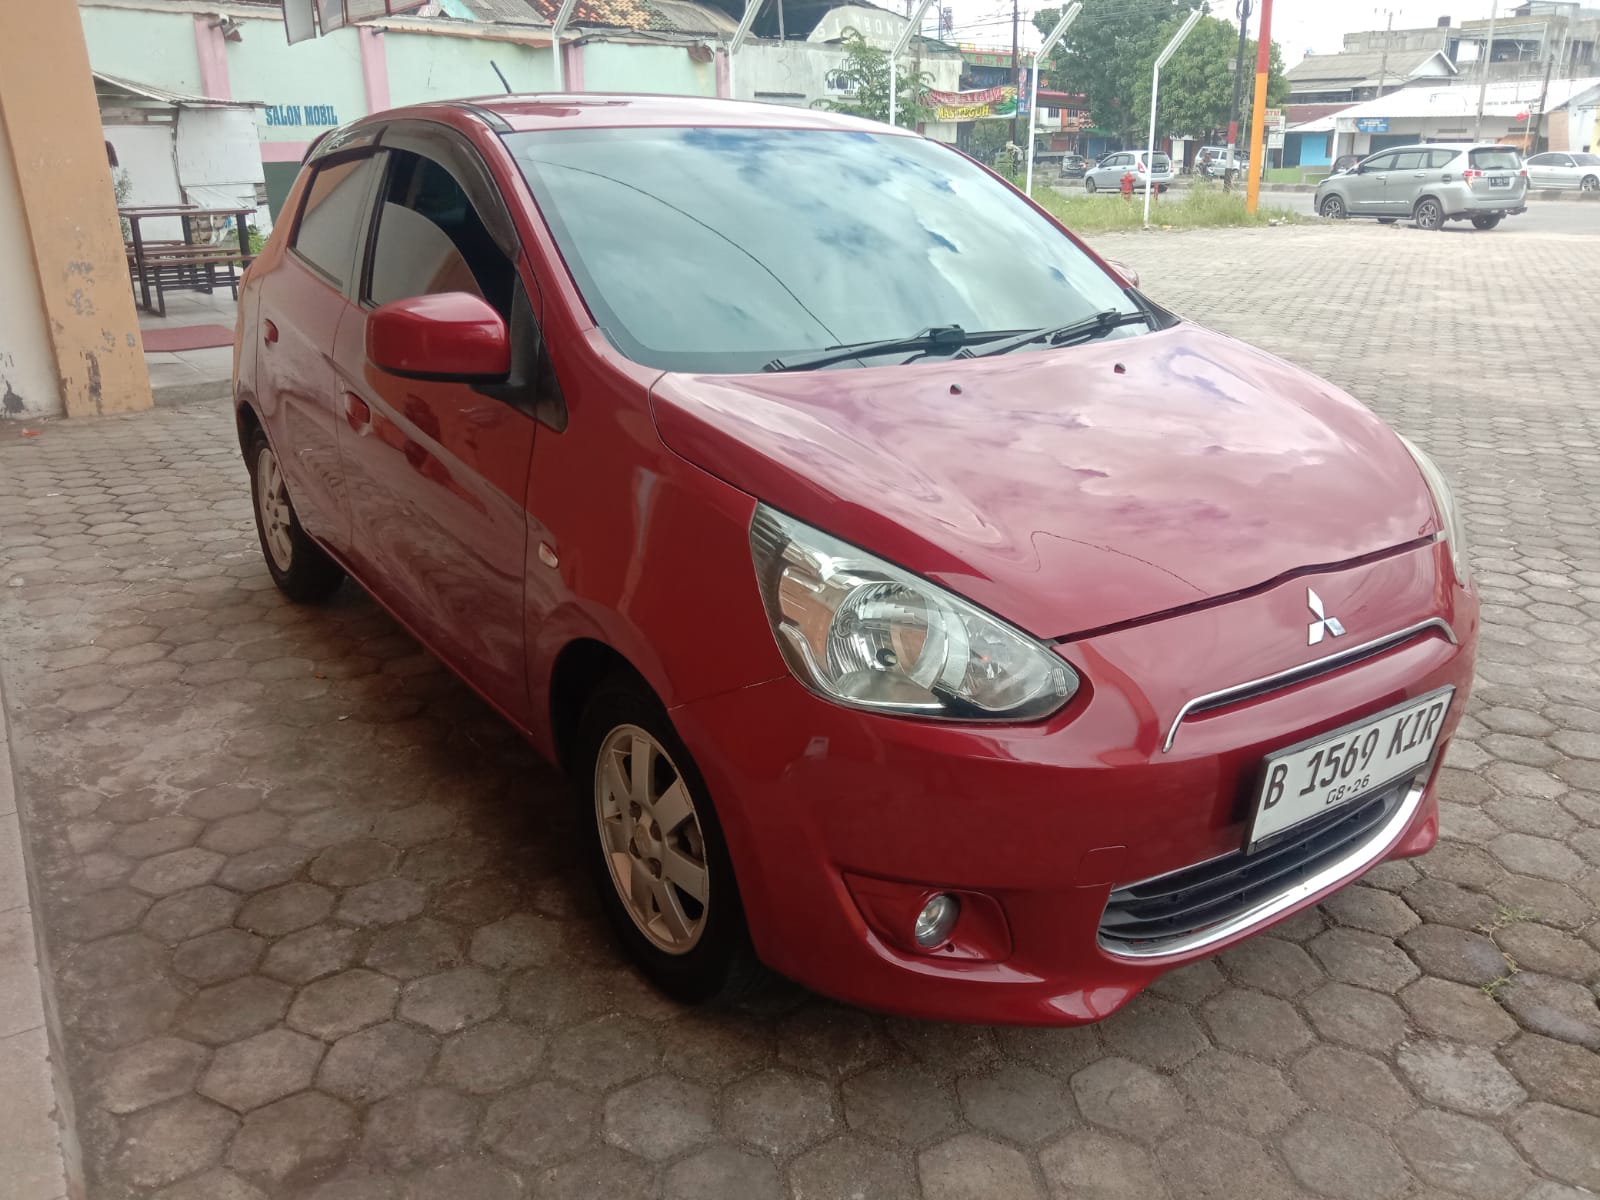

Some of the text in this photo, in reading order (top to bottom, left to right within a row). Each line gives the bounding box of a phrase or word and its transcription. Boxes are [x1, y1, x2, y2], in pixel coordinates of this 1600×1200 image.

[265, 105, 338, 126] SALON MOBIL
[1263, 701, 1444, 811] B 1569 KIR
